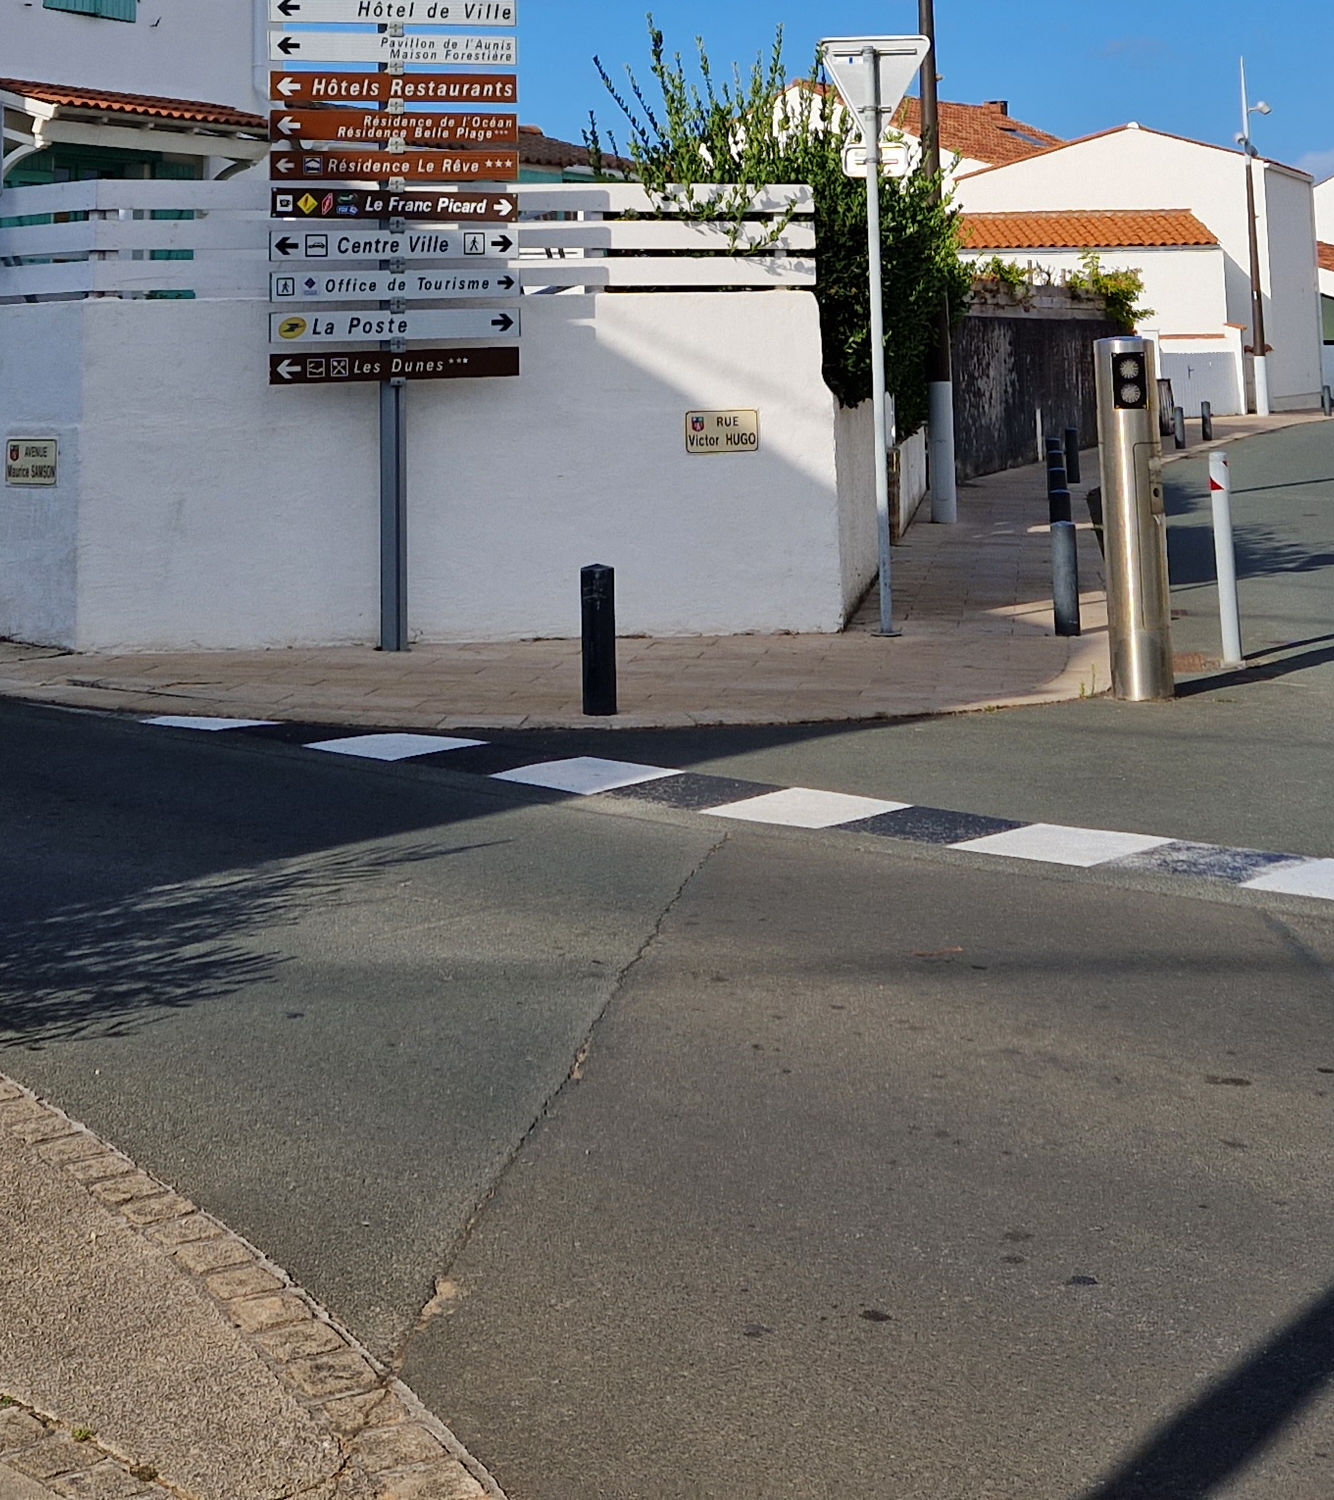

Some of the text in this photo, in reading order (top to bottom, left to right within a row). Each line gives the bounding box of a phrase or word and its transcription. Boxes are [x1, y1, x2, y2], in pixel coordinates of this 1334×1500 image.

[358, 0, 511, 20] Hôtel de Ville
[381, 37, 511, 50] Pavillon de l'Aunis
[389, 49, 512, 61] Maison Forestière
[312, 77, 513, 97] Hôtels Restaurants
[364, 116, 512, 129] Résidence de l'Océan
[338, 126, 407, 138] Résidence
[414, 127, 449, 138] Belle
[327, 158, 479, 173] Résidence Le Rêve
[365, 197, 383, 211] Le
[388, 197, 432, 212] Franc
[437, 198, 487, 214] Picard
[337, 236, 449, 254] Centre Ville
[325, 277, 490, 292] Office de Tourisme
[312, 317, 408, 335] La Poste
[354, 358, 444, 374] Les Dunes
[716, 416, 739, 427] RUE
[688, 432, 756, 447] Victor HUGO
[24, 446, 48, 457] AVENUE
